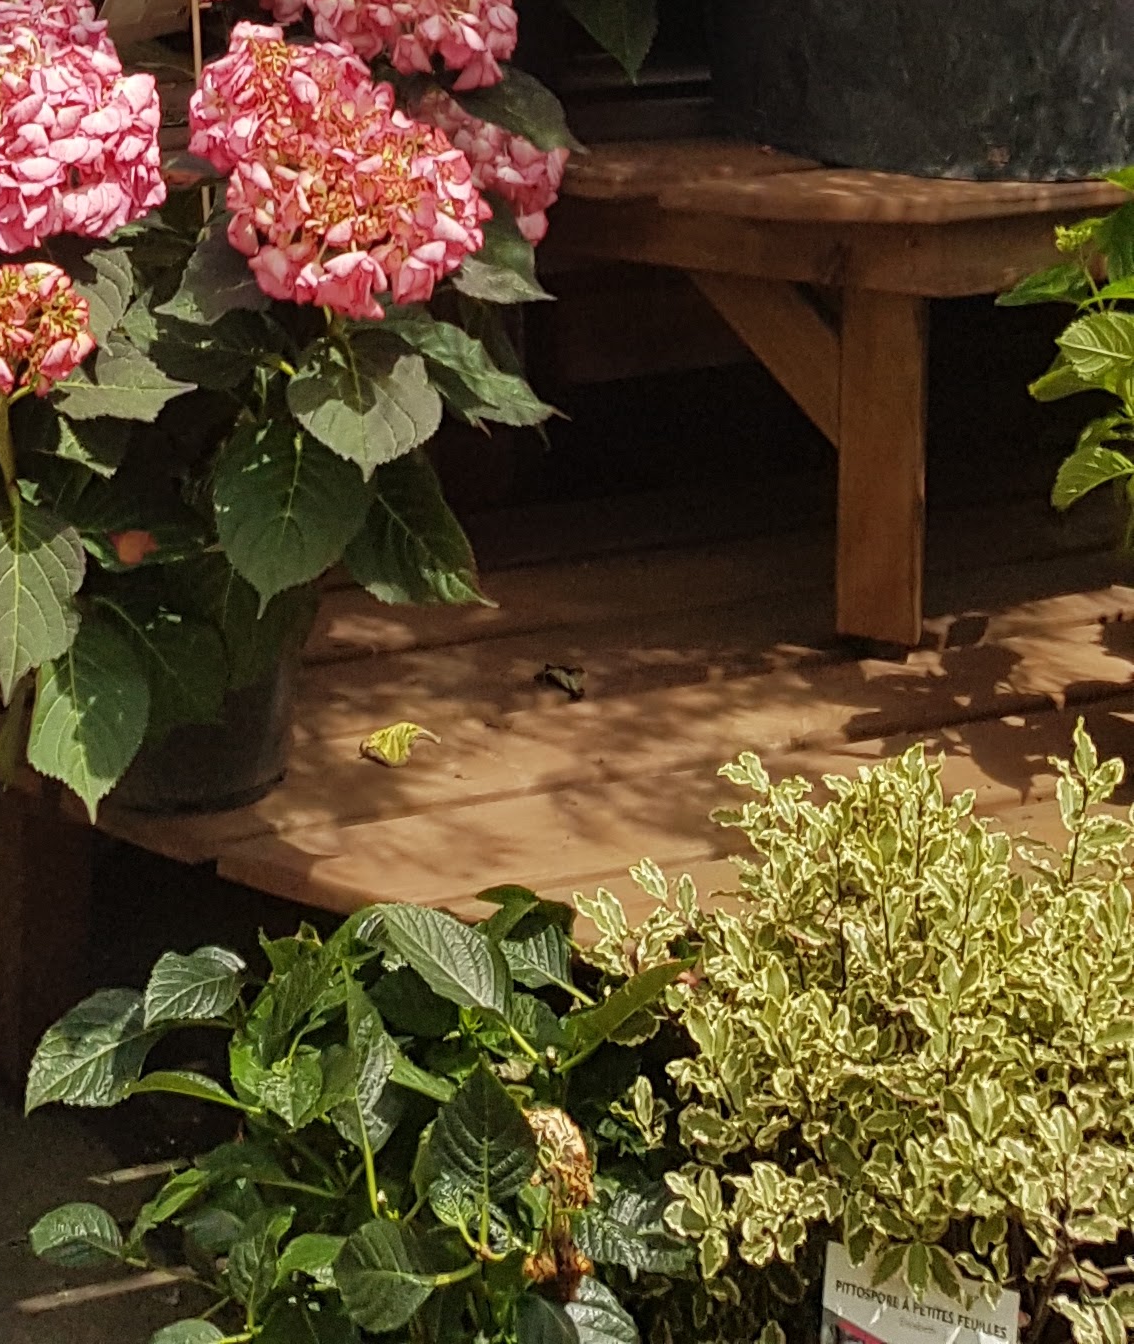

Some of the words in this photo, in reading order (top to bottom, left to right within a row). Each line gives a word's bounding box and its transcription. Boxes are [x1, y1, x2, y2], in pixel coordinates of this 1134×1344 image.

[835, 1279, 900, 1309] PITTOSPORE
[912, 1301, 954, 1325] PETITES
[957, 1314, 1008, 1339] FEUILLES
